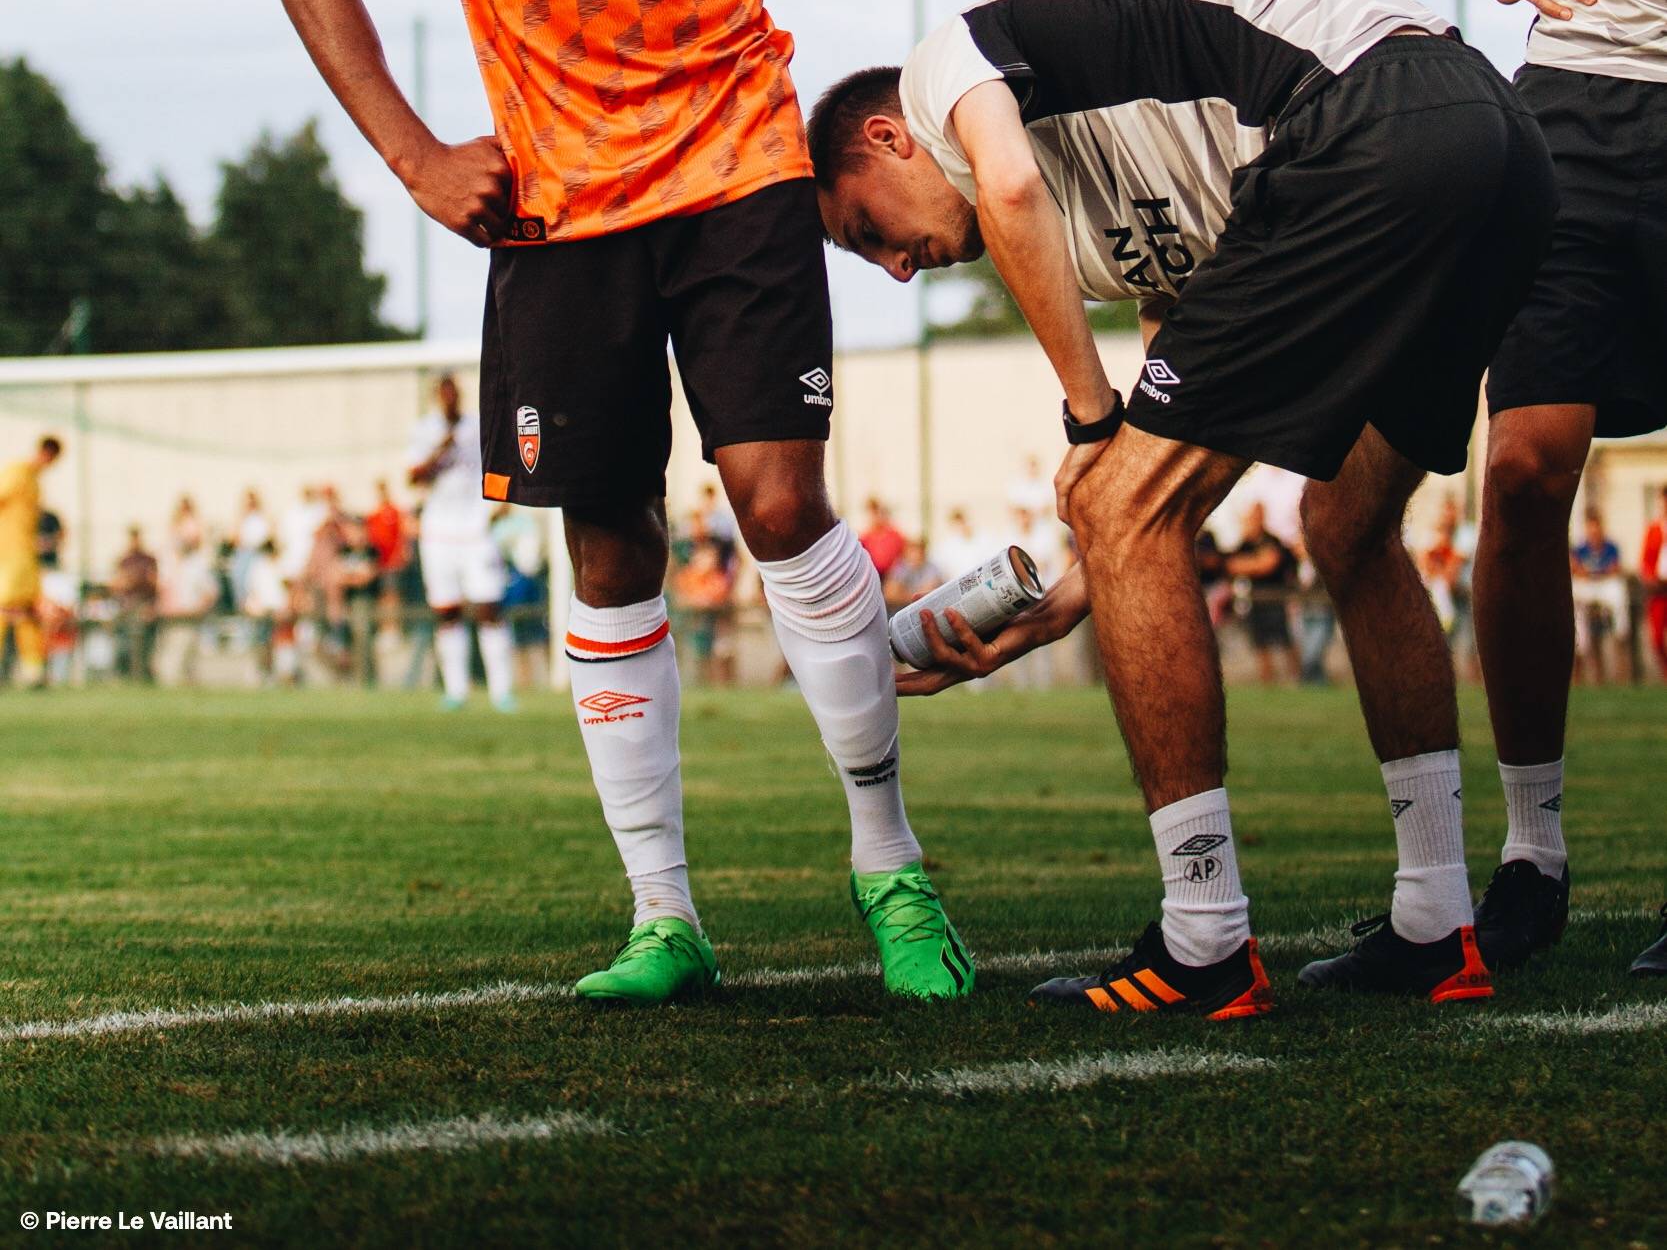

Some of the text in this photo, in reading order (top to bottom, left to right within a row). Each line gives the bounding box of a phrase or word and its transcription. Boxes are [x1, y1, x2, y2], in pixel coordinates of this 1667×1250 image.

[1104, 226, 1158, 290] AN
[803, 393, 832, 406] umbro
[584, 711, 644, 725] umbro
[855, 770, 896, 787] umbro
[1191, 858, 1215, 880] AP
